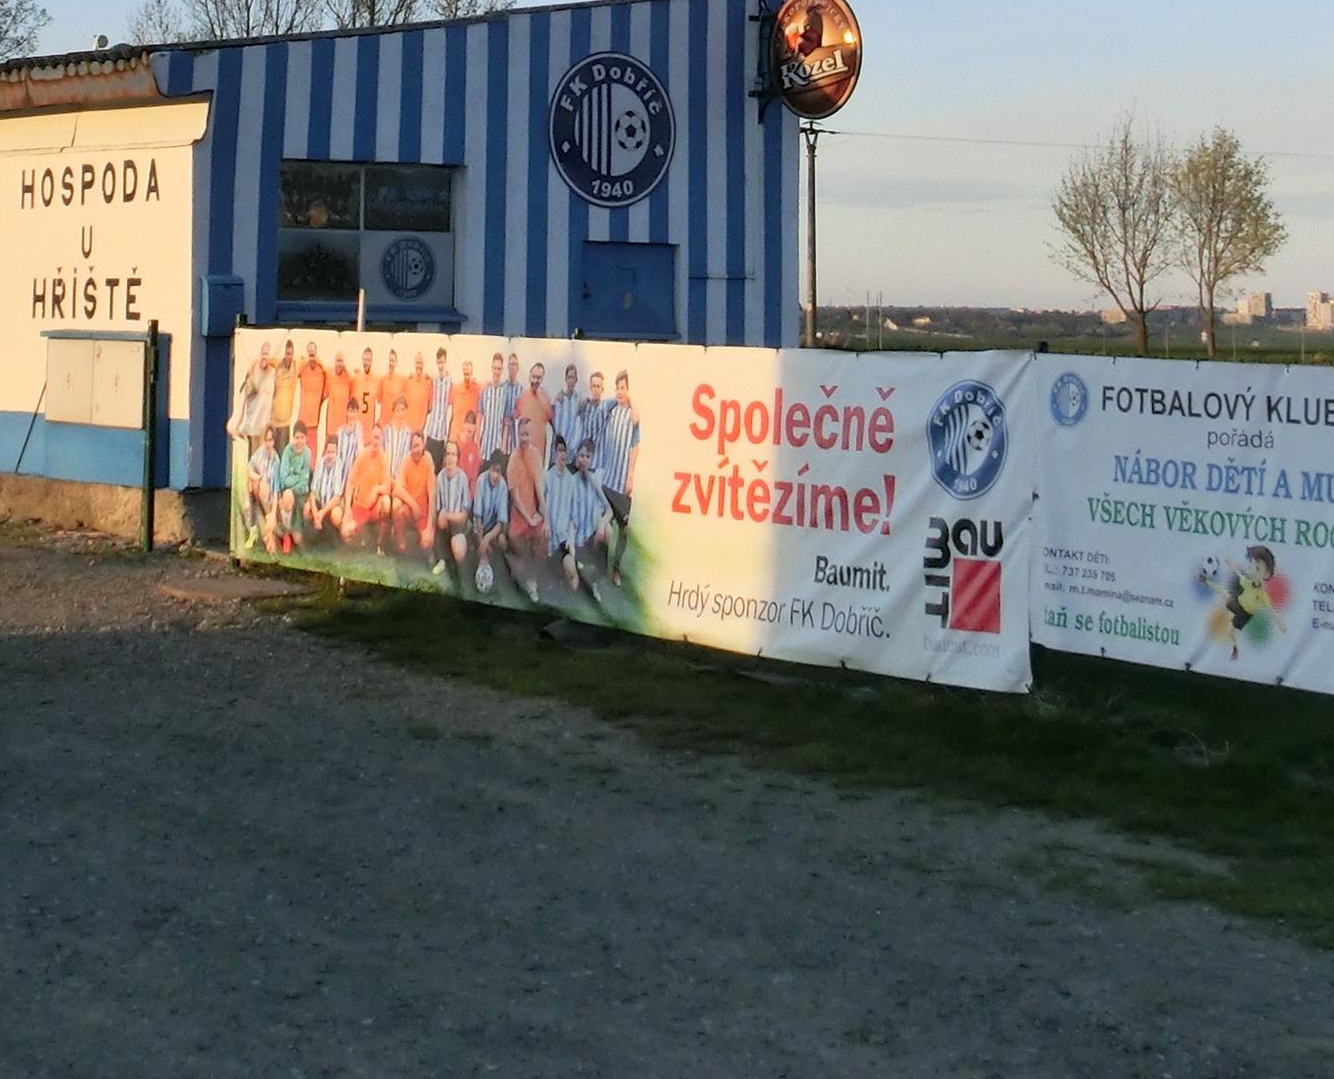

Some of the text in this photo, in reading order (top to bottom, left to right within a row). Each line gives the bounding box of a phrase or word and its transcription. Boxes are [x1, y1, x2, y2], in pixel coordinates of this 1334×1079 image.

[780, 49, 848, 90] Kozel
[560, 63, 663, 115] FK Dobříč
[21, 158, 160, 209] HOSPODA
[591, 179, 633, 198] 1940
[81, 225, 93, 259] U
[361, 391, 370, 414] 5
[689, 383, 896, 456] Společně
[1102, 386, 1256, 421] FOTBALOVÝ
[1207, 428, 1274, 449] pořádá
[1113, 448, 1197, 490] NÁBOR
[1206, 456, 1267, 497] DĚTÍ
[1272, 469, 1293, 499] A
[672, 456, 896, 535] zvítězíme!
[1087, 491, 1156, 529] VŠECH
[1163, 500, 1287, 544] VĚKOVÝCH
[1043, 547, 1085, 561] ONTAKT
[1062, 566, 1079, 578] 737
[813, 555, 890, 592] Baumit.
[667, 580, 891, 639] Hrdý sponzor FK Dobříč.
[1075, 613, 1093, 631] se
[1098, 611, 1180, 645] fotbalistou
